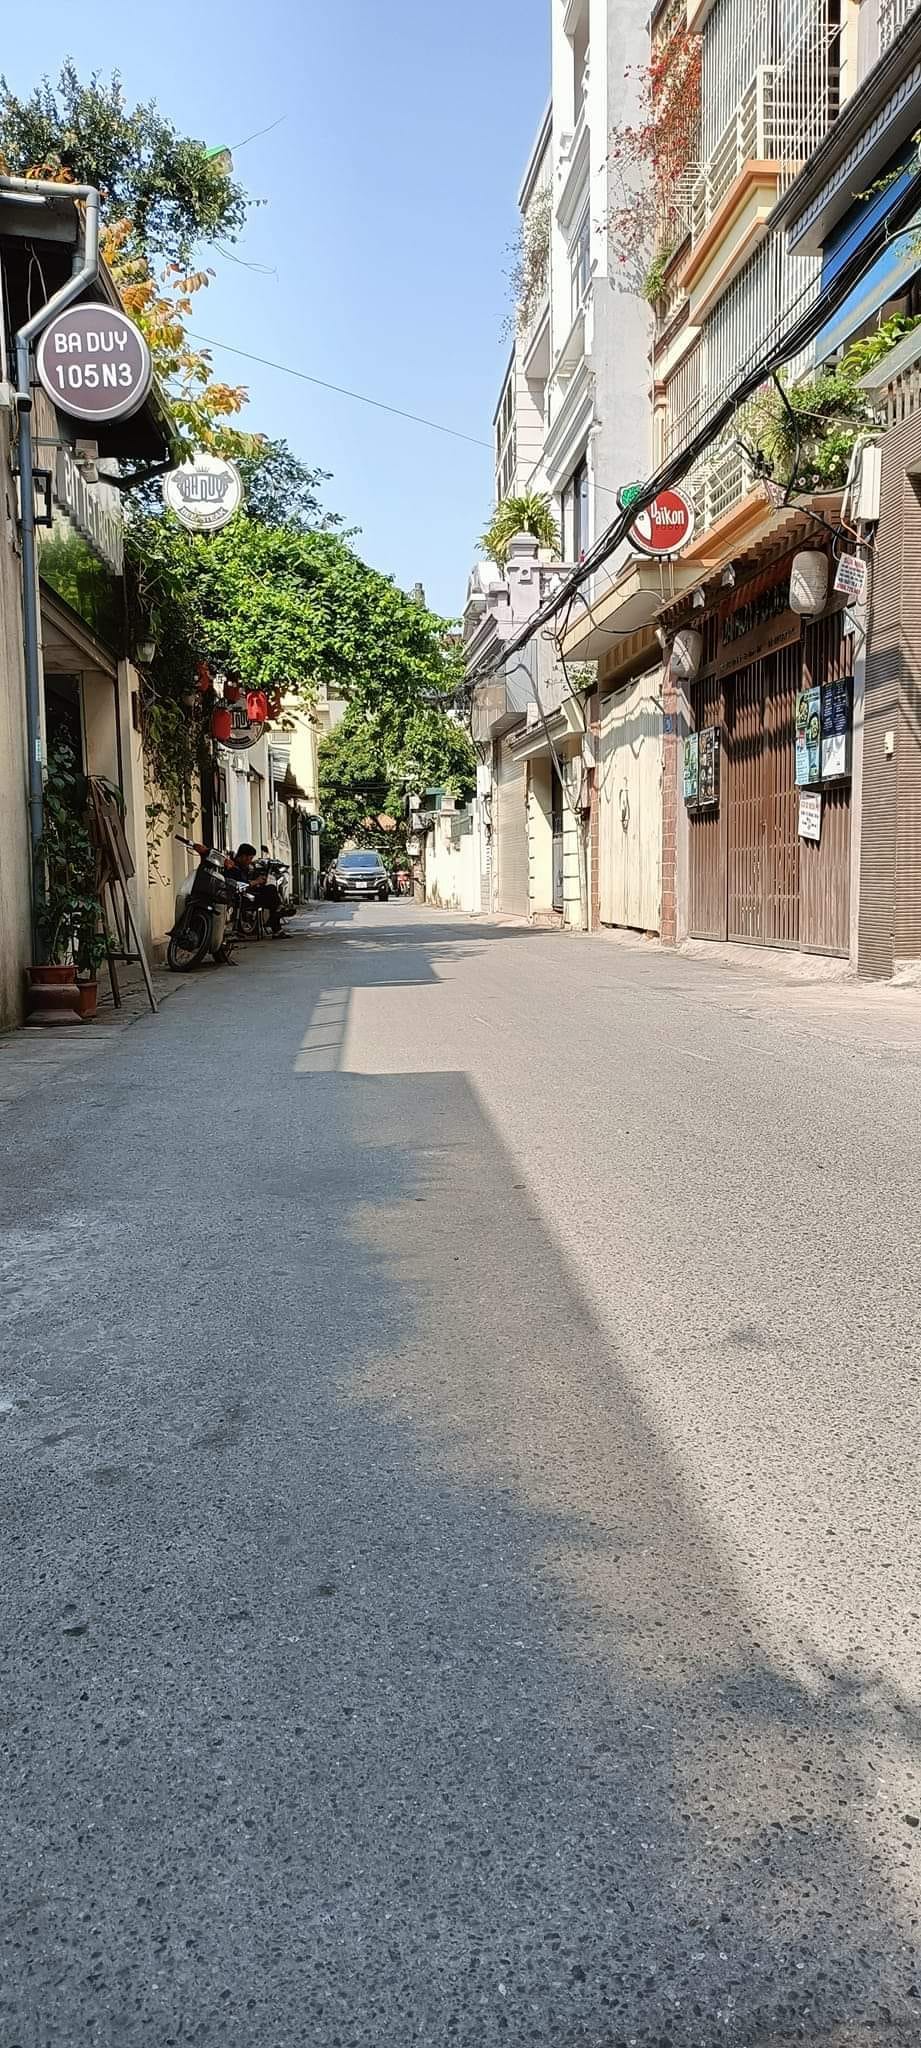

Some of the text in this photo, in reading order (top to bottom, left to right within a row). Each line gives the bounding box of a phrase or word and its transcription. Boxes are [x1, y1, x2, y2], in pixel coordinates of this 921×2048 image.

[54, 331, 128, 353] BA DUY
[651, 499, 685, 525] Daikon
